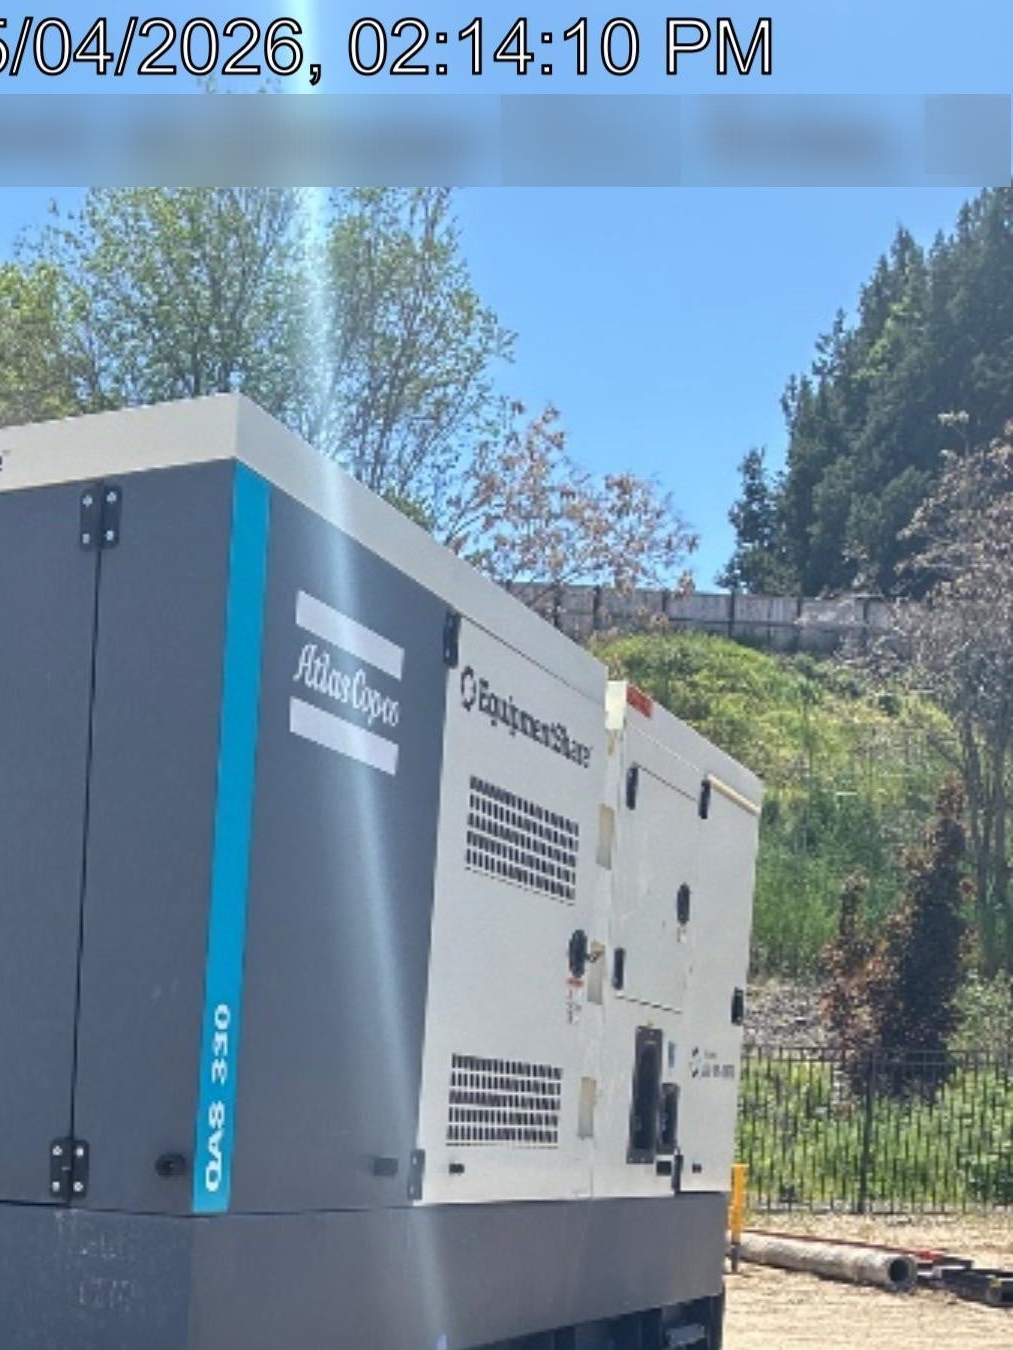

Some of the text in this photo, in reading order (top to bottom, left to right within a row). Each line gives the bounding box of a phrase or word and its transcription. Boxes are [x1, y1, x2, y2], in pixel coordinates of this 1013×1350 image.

[292, 642, 400, 727] Atlas Copco
[204, 1003, 231, 1192] QAS 330
